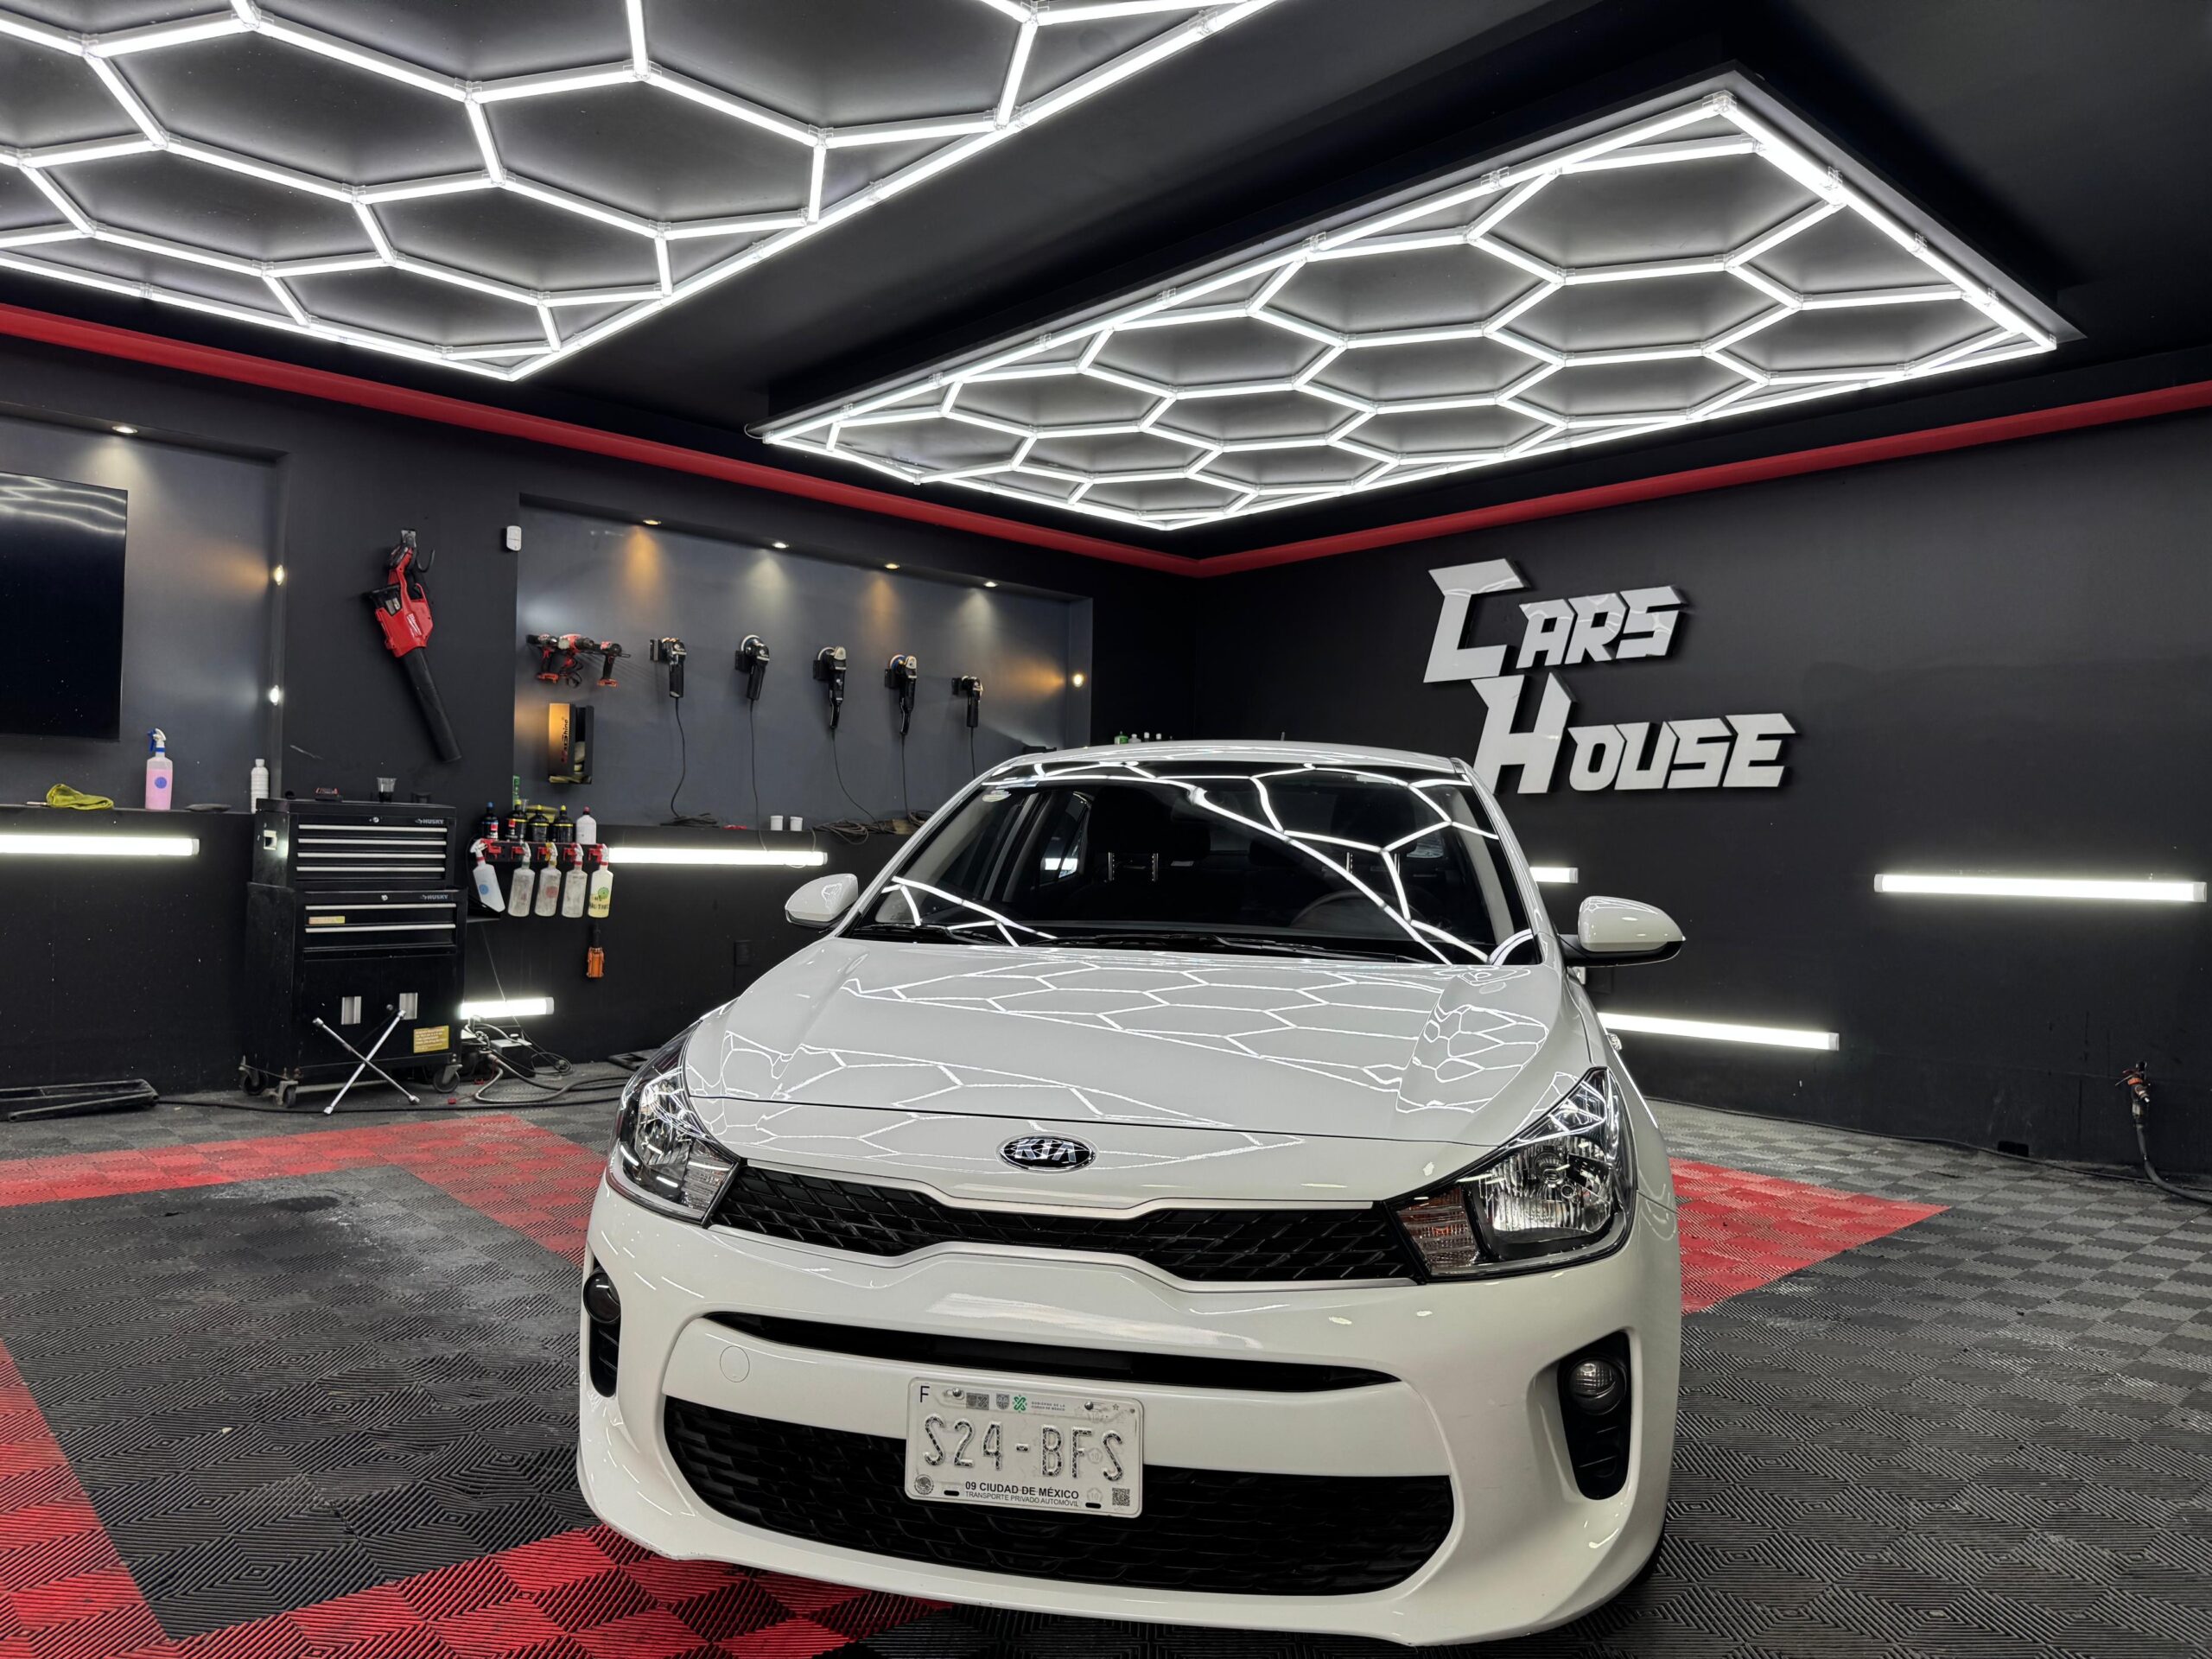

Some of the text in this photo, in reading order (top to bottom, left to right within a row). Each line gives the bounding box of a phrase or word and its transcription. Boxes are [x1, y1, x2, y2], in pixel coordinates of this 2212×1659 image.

[1423, 558, 1684, 683] CARS
[1470, 671, 1796, 794] HOUSE
[1014, 1138, 1077, 1163] KIA
[920, 1385, 931, 1403] F
[924, 1414, 1123, 1481] S24-BFS
[965, 1481, 1079, 1499] 09 CIUDAD DE MÉXICO
[965, 1491, 1009, 1501] TRANSPORTE
[1010, 1495, 1039, 1503] PRIVADO
